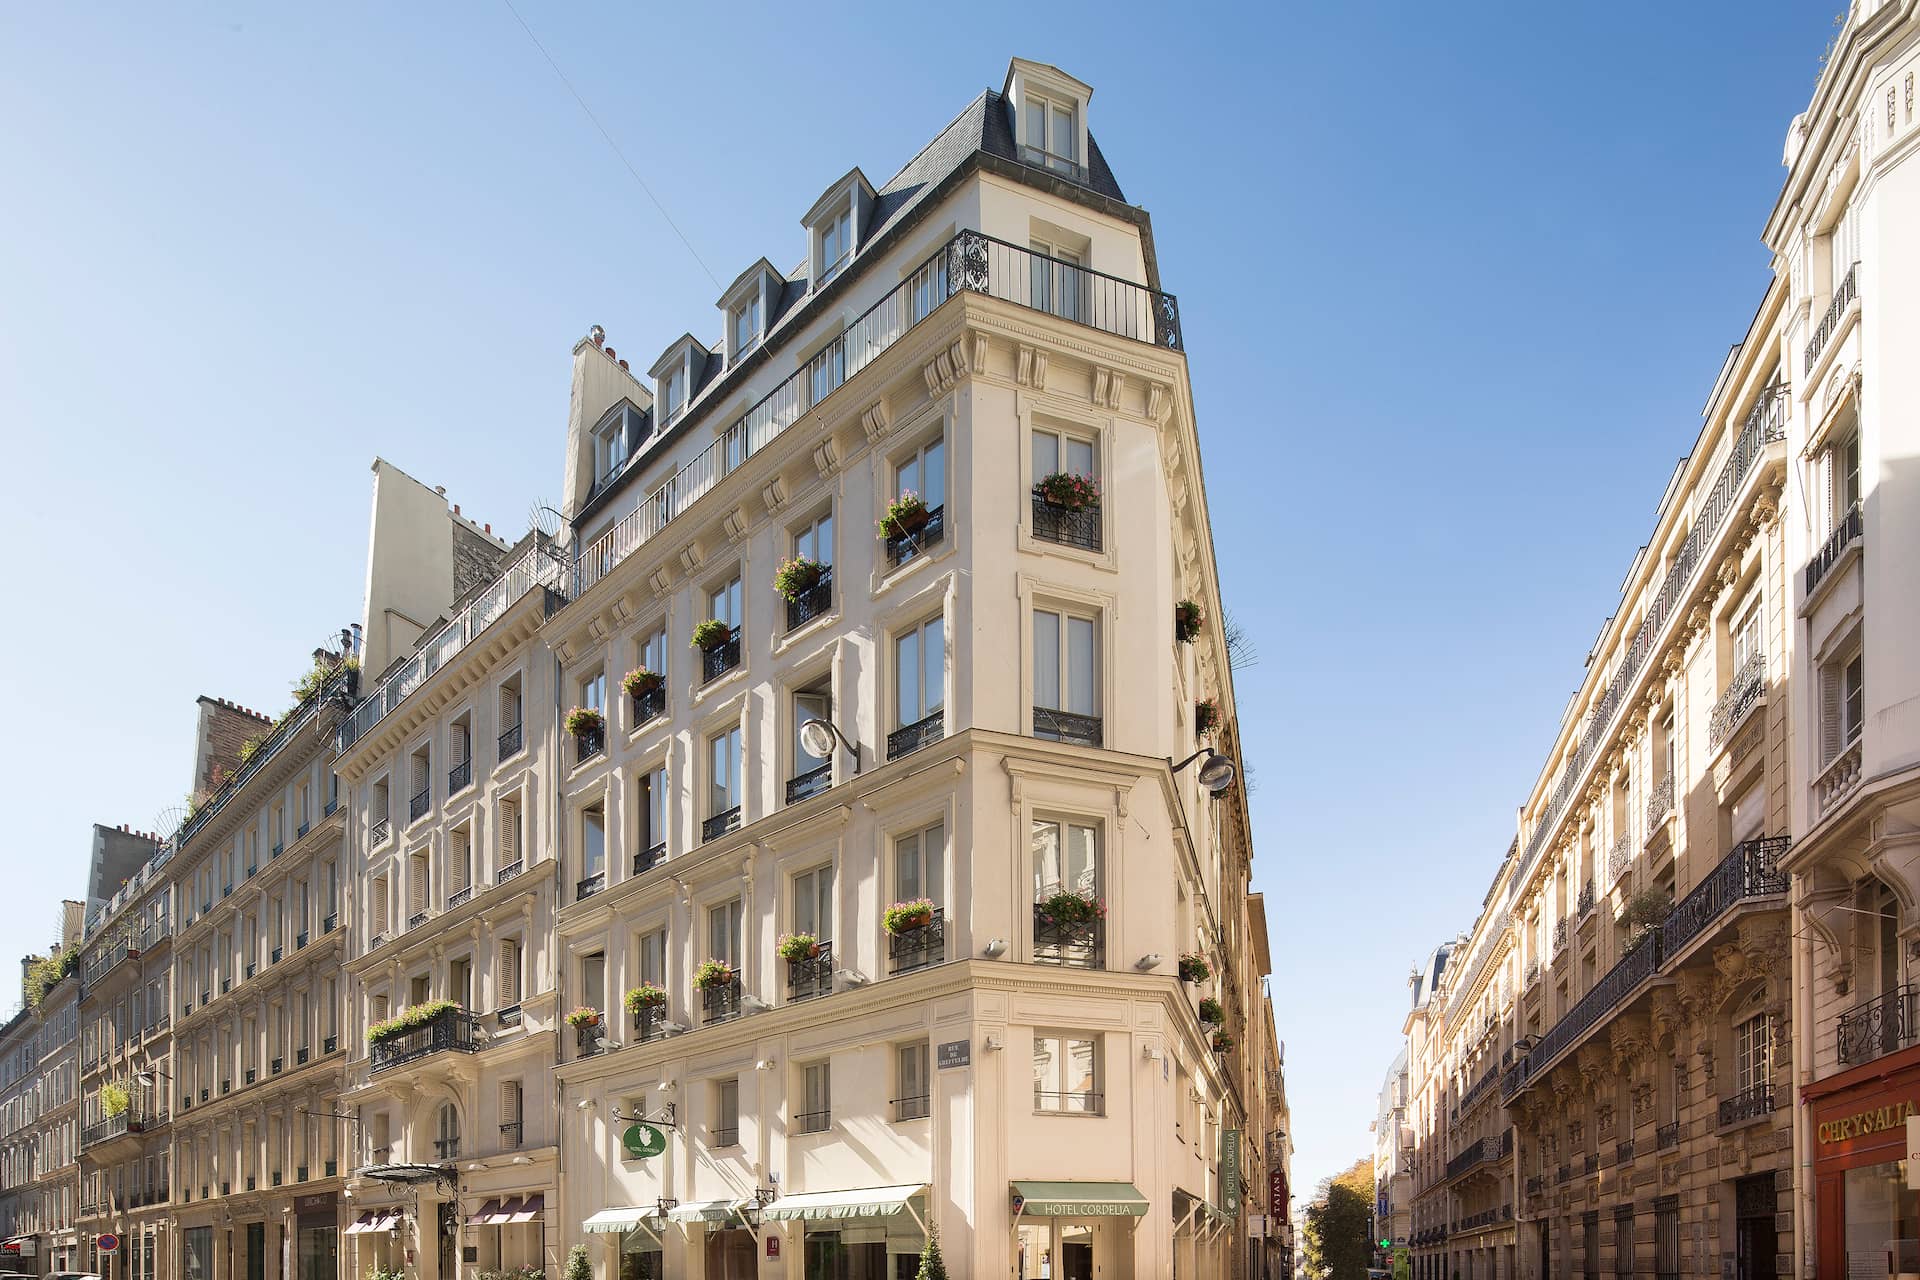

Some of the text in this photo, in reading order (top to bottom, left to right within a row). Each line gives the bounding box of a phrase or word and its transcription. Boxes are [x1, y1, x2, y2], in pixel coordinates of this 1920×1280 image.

[1818, 1099, 1918, 1145] CHRYSALIA
[1227, 1132, 1235, 1194] HOTEL CORDELIA
[1045, 1203, 1131, 1216] HOTEL CORDELIA
